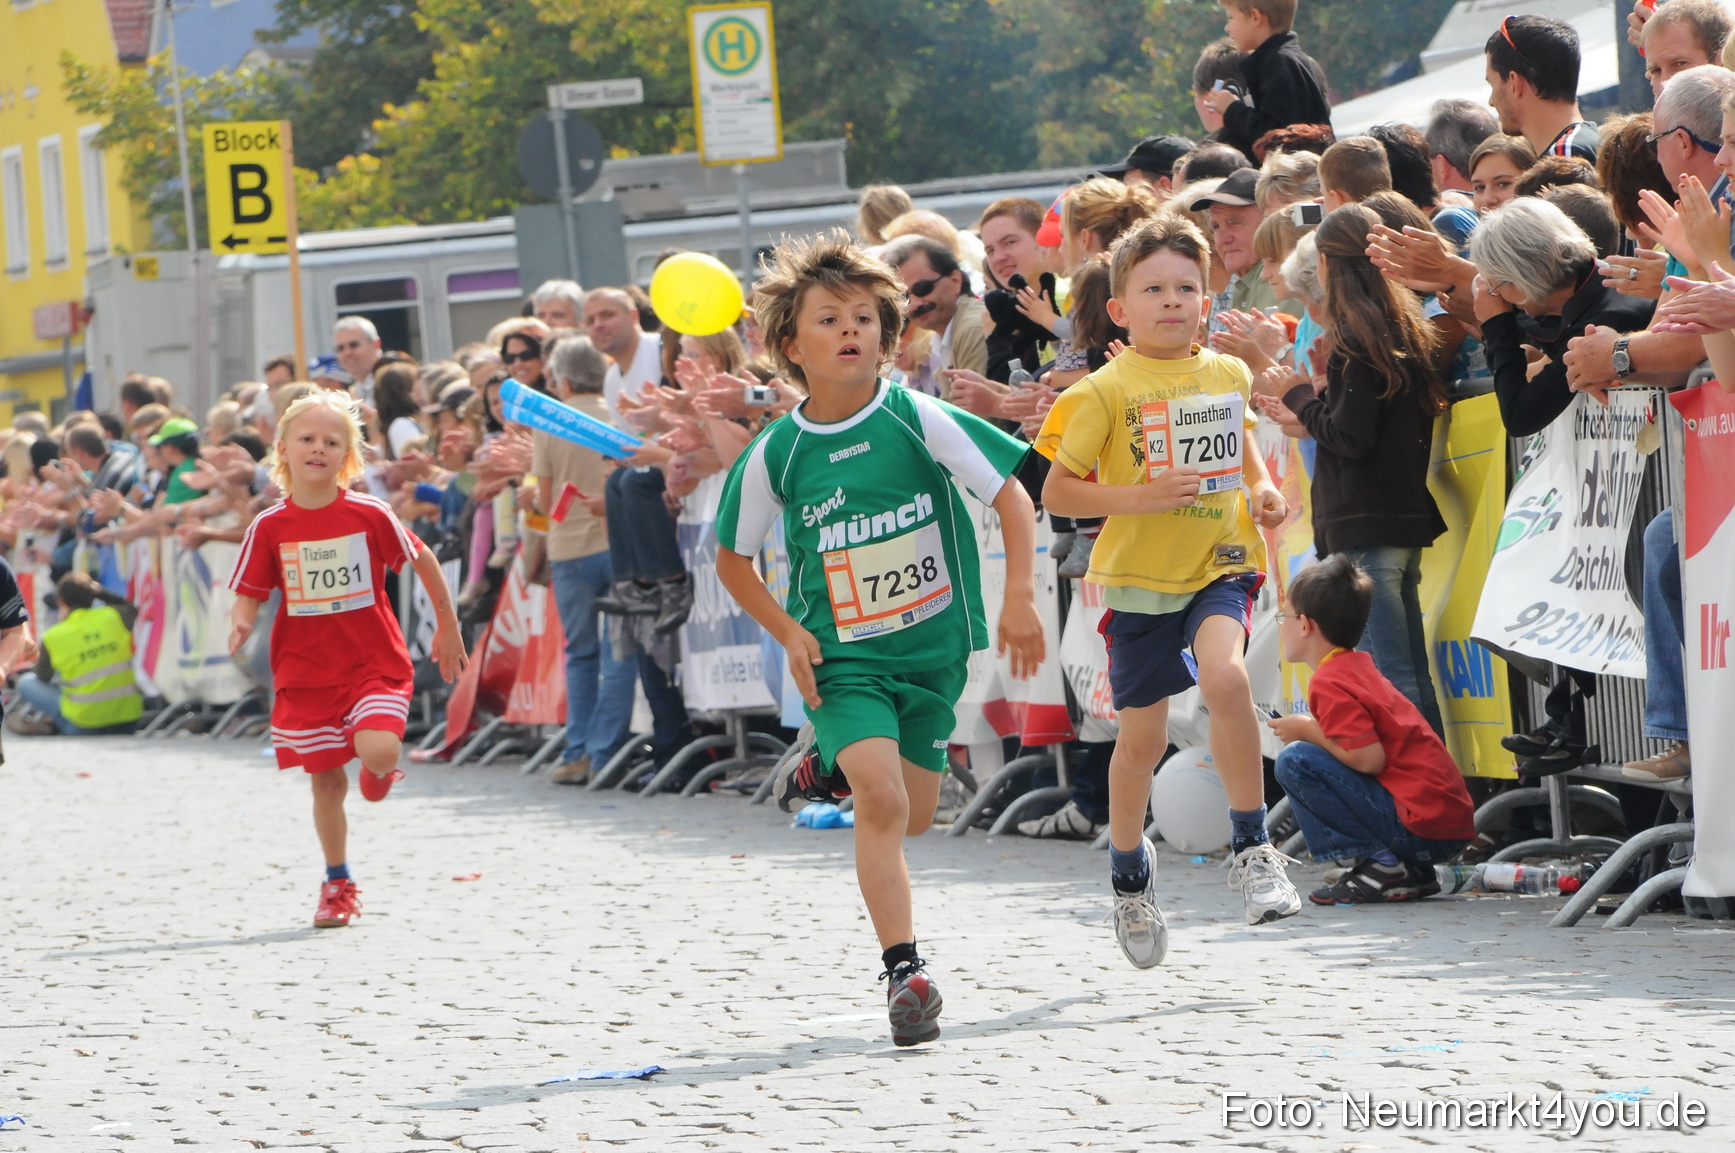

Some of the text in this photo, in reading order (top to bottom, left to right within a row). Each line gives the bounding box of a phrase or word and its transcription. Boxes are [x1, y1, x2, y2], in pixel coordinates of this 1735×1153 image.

[213, 128, 282, 152] Block
[229, 163, 272, 224] B
[1175, 403, 1232, 427] Jonathan
[829, 441, 871, 463] DERBYSTAR
[1149, 439, 1164, 454] K2
[1178, 431, 1237, 465] 7200
[802, 486, 846, 528] Sport
[1173, 505, 1223, 520] STREAM
[817, 492, 934, 553] Münch
[302, 547, 337, 562] Tizian
[287, 569, 297, 581] K2
[307, 563, 362, 590] 7031
[862, 555, 938, 603] 7238
[913, 591, 952, 616] PFLEIDERER
[1504, 601, 1604, 654] 92318
[1700, 603, 1730, 670] Ihr
